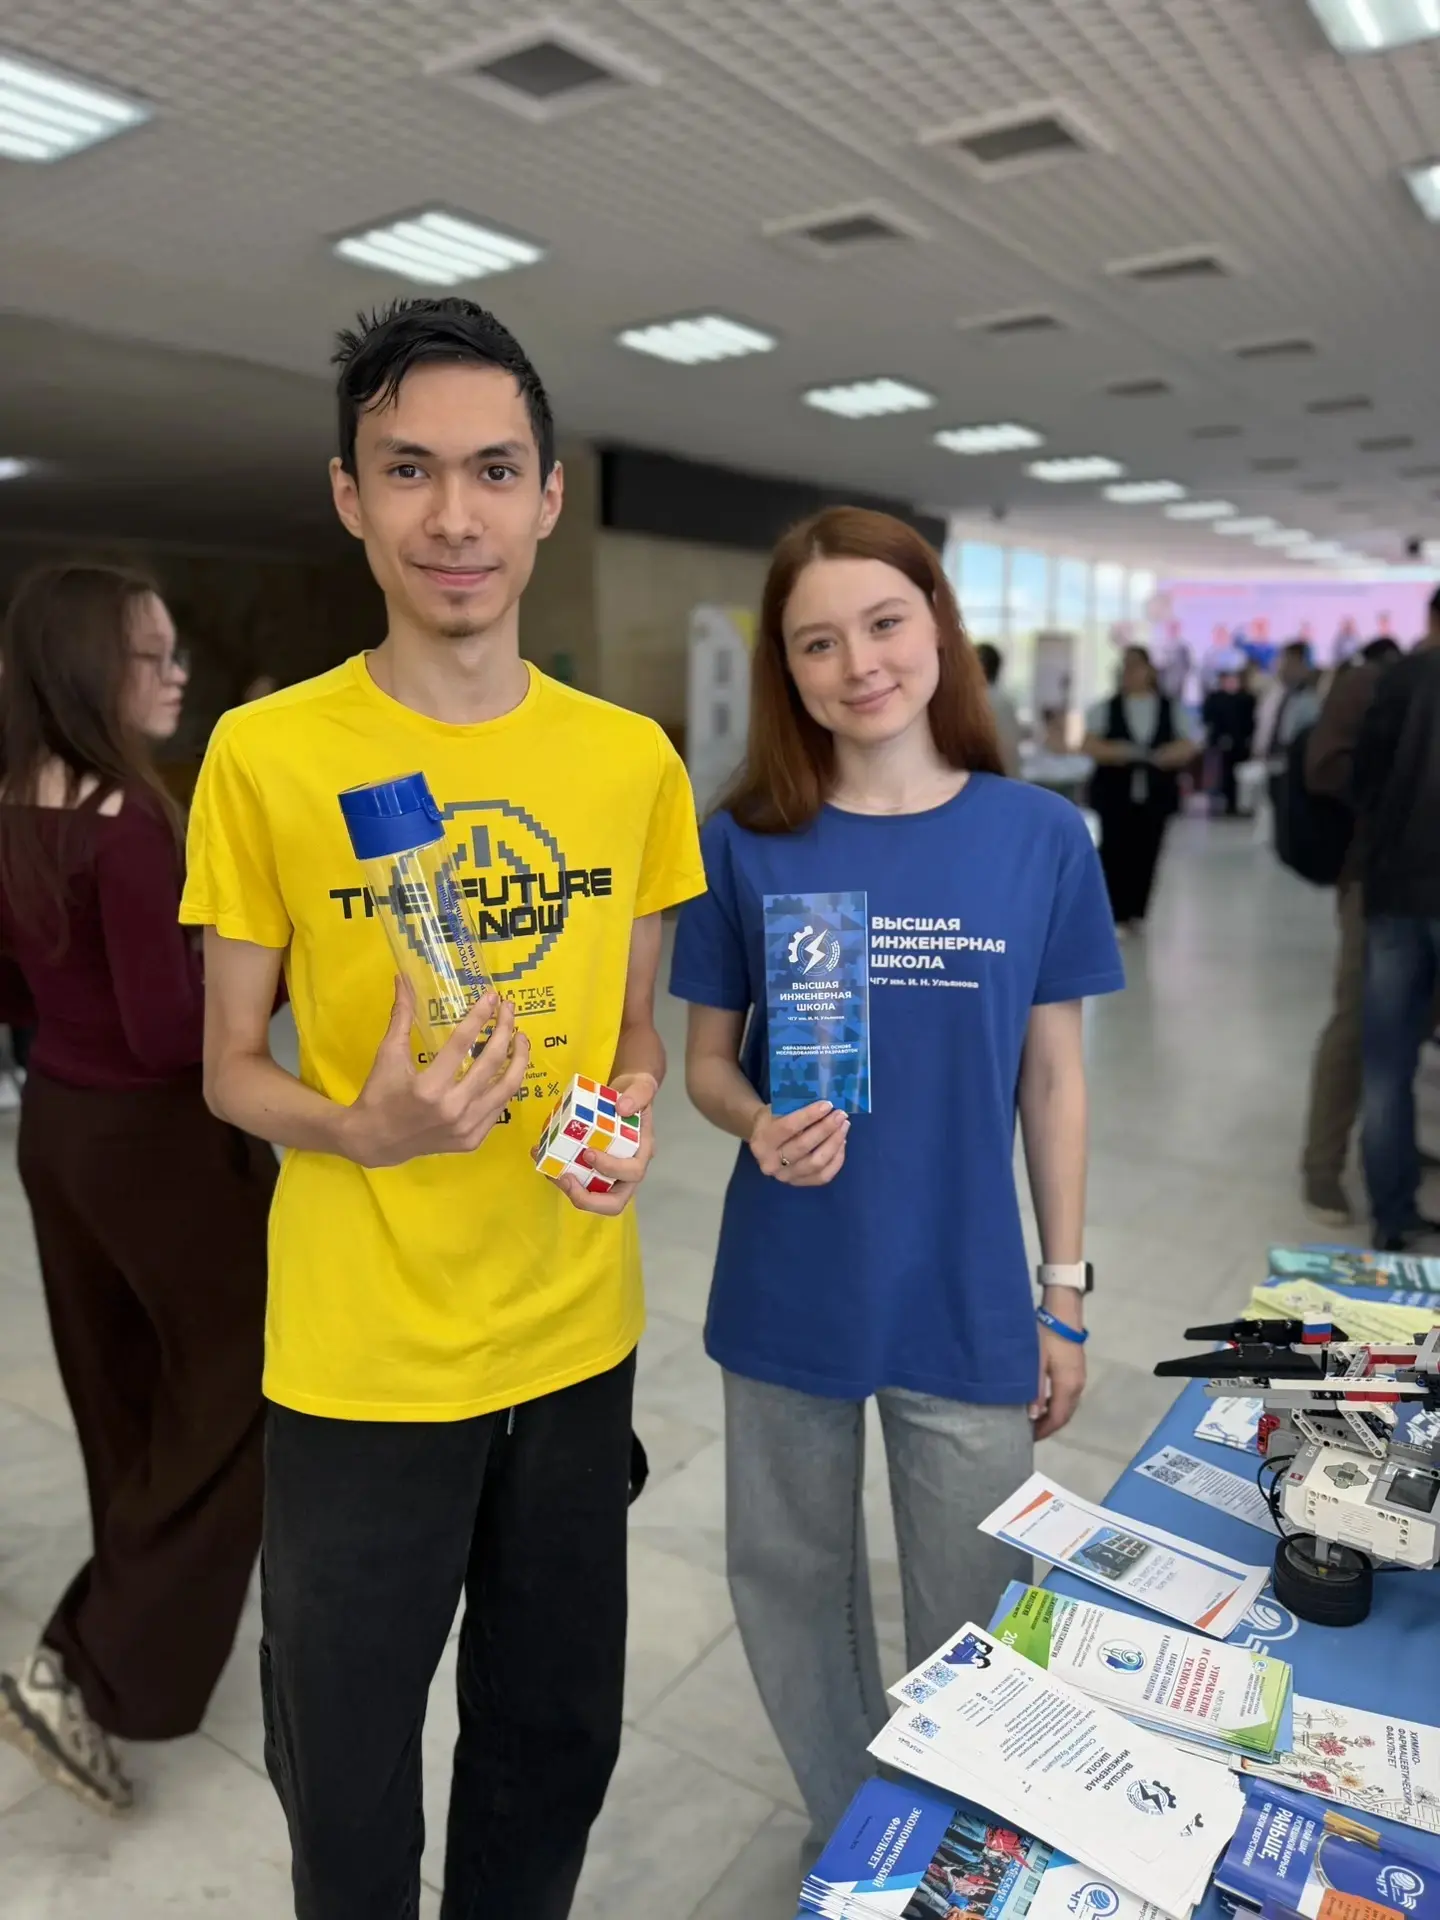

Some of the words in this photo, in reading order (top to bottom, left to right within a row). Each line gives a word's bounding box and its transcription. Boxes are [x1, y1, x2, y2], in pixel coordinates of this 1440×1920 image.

[452, 868, 613, 906] FUTURE
[478, 903, 565, 940] NOW
[872, 916, 961, 931] ВЫСШАЯ
[871, 936, 1006, 953] ИНЖЕНЕРНАЯ
[871, 955, 945, 969] ШКОЛА
[780, 991, 852, 1001] ИНЖЕНЕРНАЯ
[792, 980, 839, 990] ВЫСШАЯ
[870, 977, 888, 986] ЧГУ
[932, 979, 979, 988] Ульянова
[796, 1002, 835, 1012] ШКОЛА
[525, 1070, 547, 1080] future
[998, 1629, 1018, 1646] 20
[1201, 1647, 1211, 1655] И
[1163, 1652, 1178, 1676] КАФЕДРА
[1153, 1675, 1171, 1705] СОЦИАЛЬНОЙ
[1169, 1656, 1195, 1710] ТЕХНОЛОГИЙ
[1182, 1656, 1209, 1713] СОЦИАЛЬНЫХ
[1196, 1664, 1221, 1718] УПРАВЛЕНИЯ
[1209, 1688, 1225, 1722] ФАКУЛЬТЕТ
[1059, 1736, 1097, 1770] Специалисты
[1386, 1724, 1396, 1769] ФАКУЛЬТЕТ
[1409, 1729, 1419, 1766] ХИМИКО-
[1083, 1750, 1112, 1777] ШКОЛА
[1083, 1747, 1131, 1792] ИНЖЕНЕРНАЯ
[1101, 1760, 1134, 1792] ВЫСШАЯ
[1398, 1727, 1414, 1807] ФАРМАЦЕВТИЧЕСКИЙ
[865, 1814, 902, 1870] ФАКУЛЬТЕТ
[1255, 1806, 1293, 1864] РАНЬШЕ,
[1301, 1819, 1316, 1841] СДЕЛАЙ
[870, 1805, 922, 1889] ЭКОНОМИЧЕСКИЙ
[1240, 1825, 1263, 1867] СВЕРСТНИКИ
[1296, 1838, 1309, 1855] ШАГ
[1275, 1848, 1293, 1879] КАРЬЕРЕ
[986, 1904, 1001, 1920] ФА
[1064, 1888, 1082, 1914] ЧГУ
